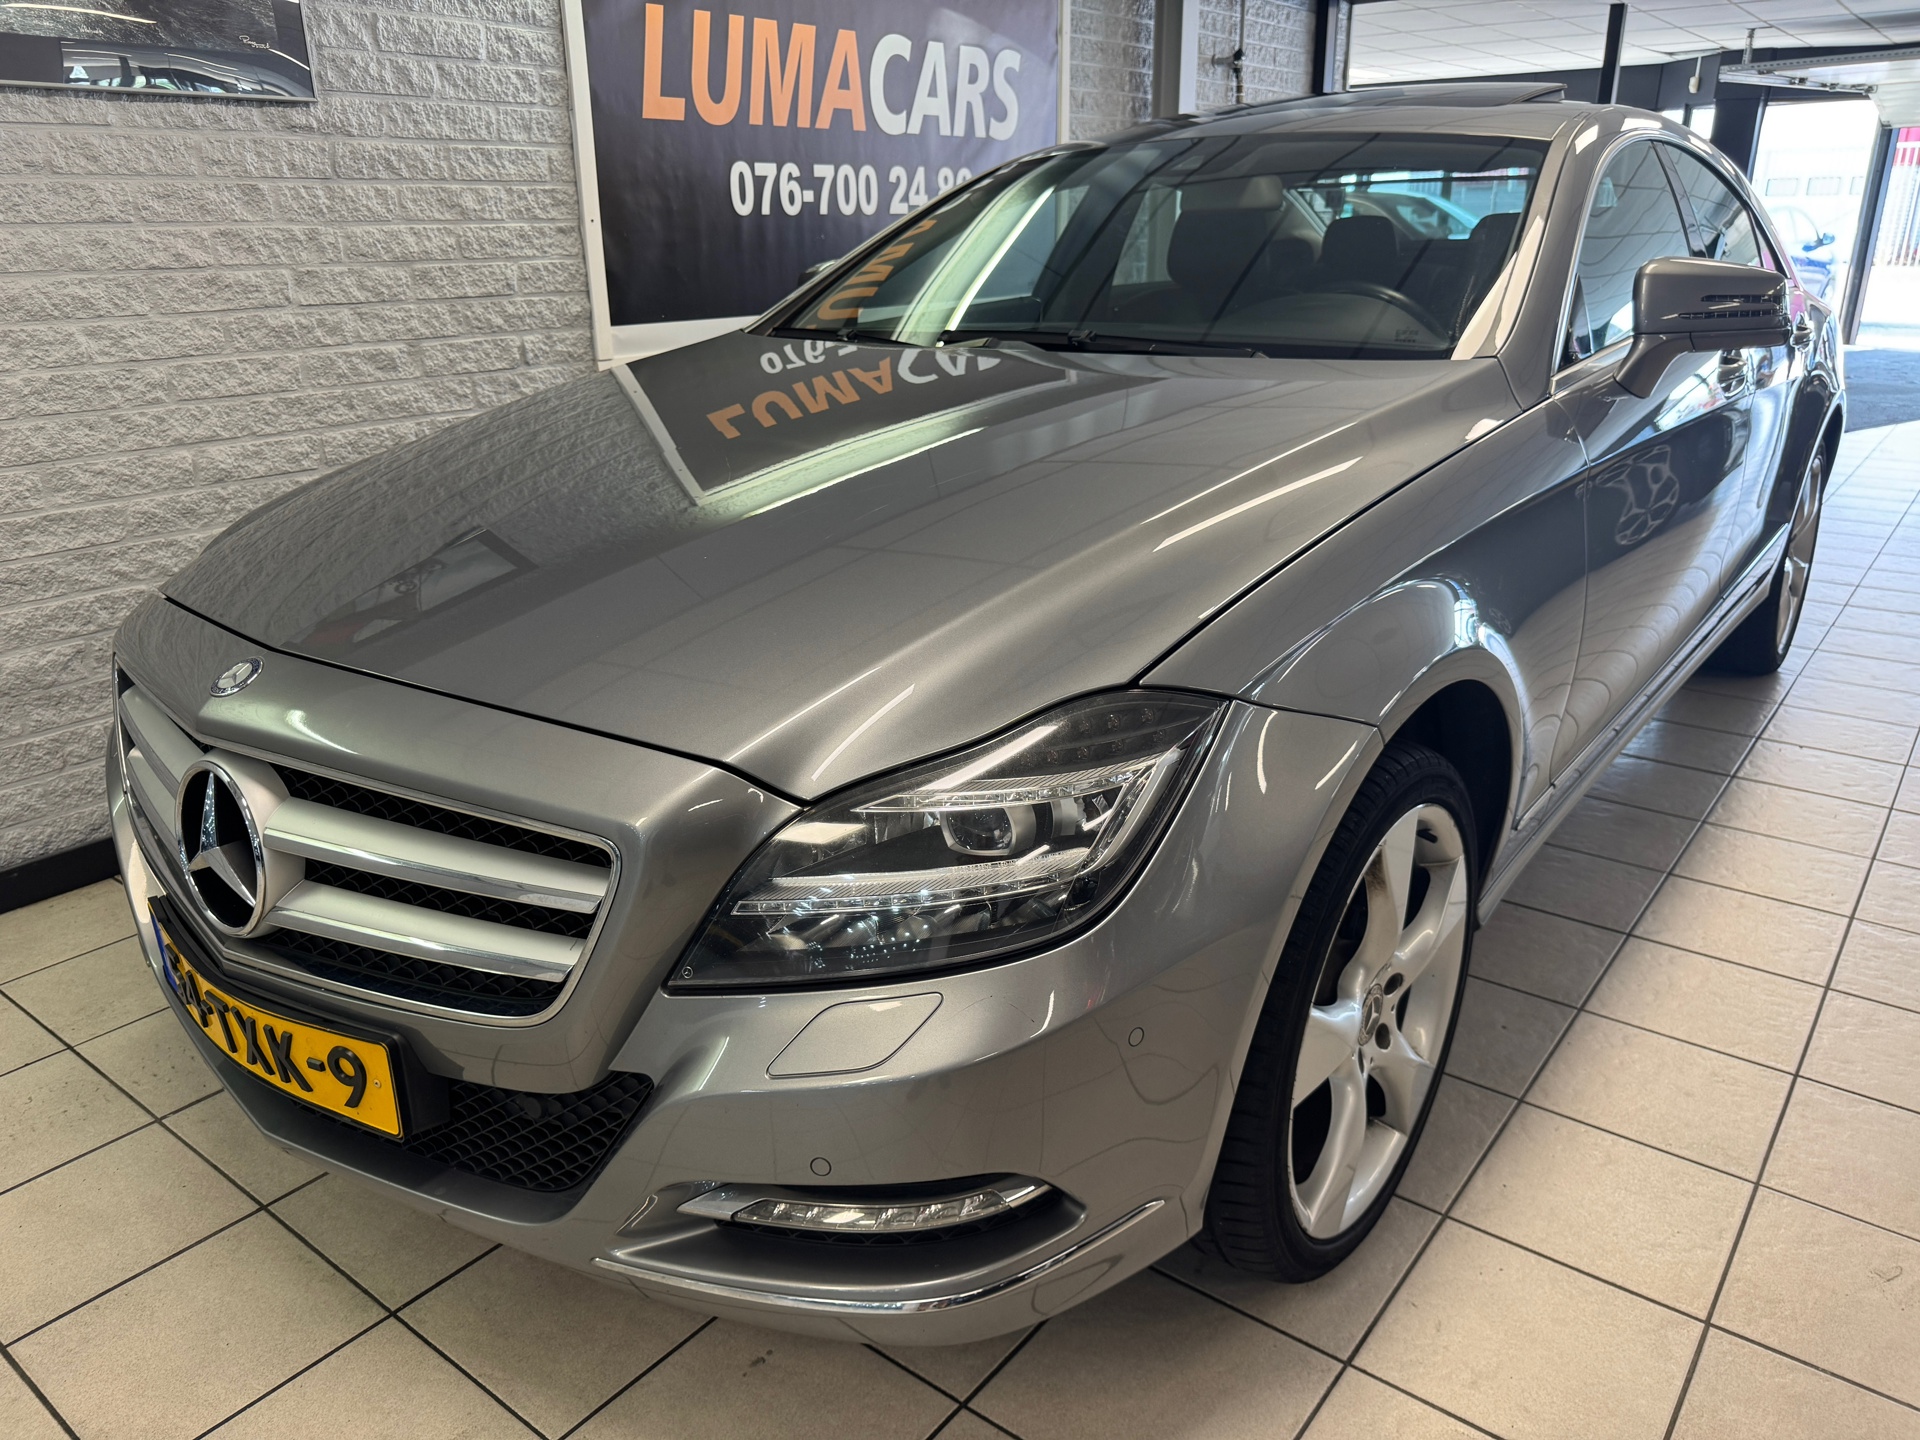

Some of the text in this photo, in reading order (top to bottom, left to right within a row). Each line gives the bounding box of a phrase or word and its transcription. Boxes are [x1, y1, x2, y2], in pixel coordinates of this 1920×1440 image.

[642, 3, 1021, 141] LUMACARS
[730, 160, 878, 216] 076-700
[888, 165, 928, 214] 24
